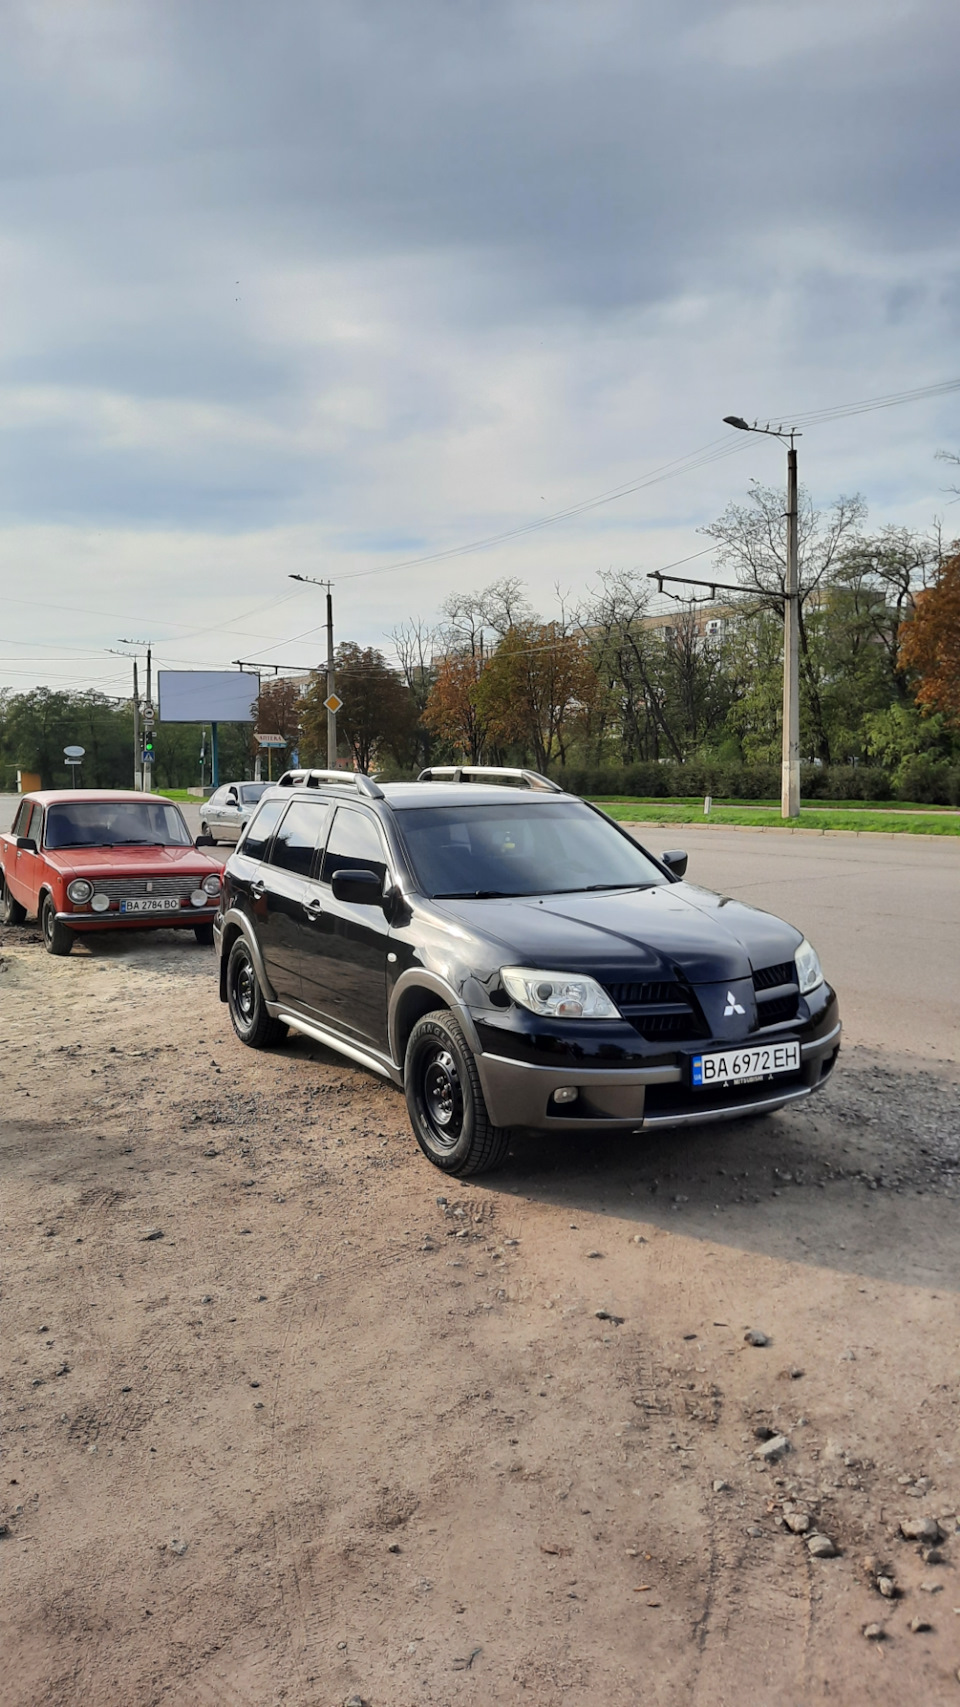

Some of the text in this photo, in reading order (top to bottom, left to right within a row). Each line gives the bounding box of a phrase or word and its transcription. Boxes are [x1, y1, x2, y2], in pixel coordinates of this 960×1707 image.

[126, 901, 139, 910] BA
[142, 900, 162, 910] 2784
[704, 1046, 797, 1080] BA 6972 EH
[733, 1075, 764, 1085] MITSUBISHI
